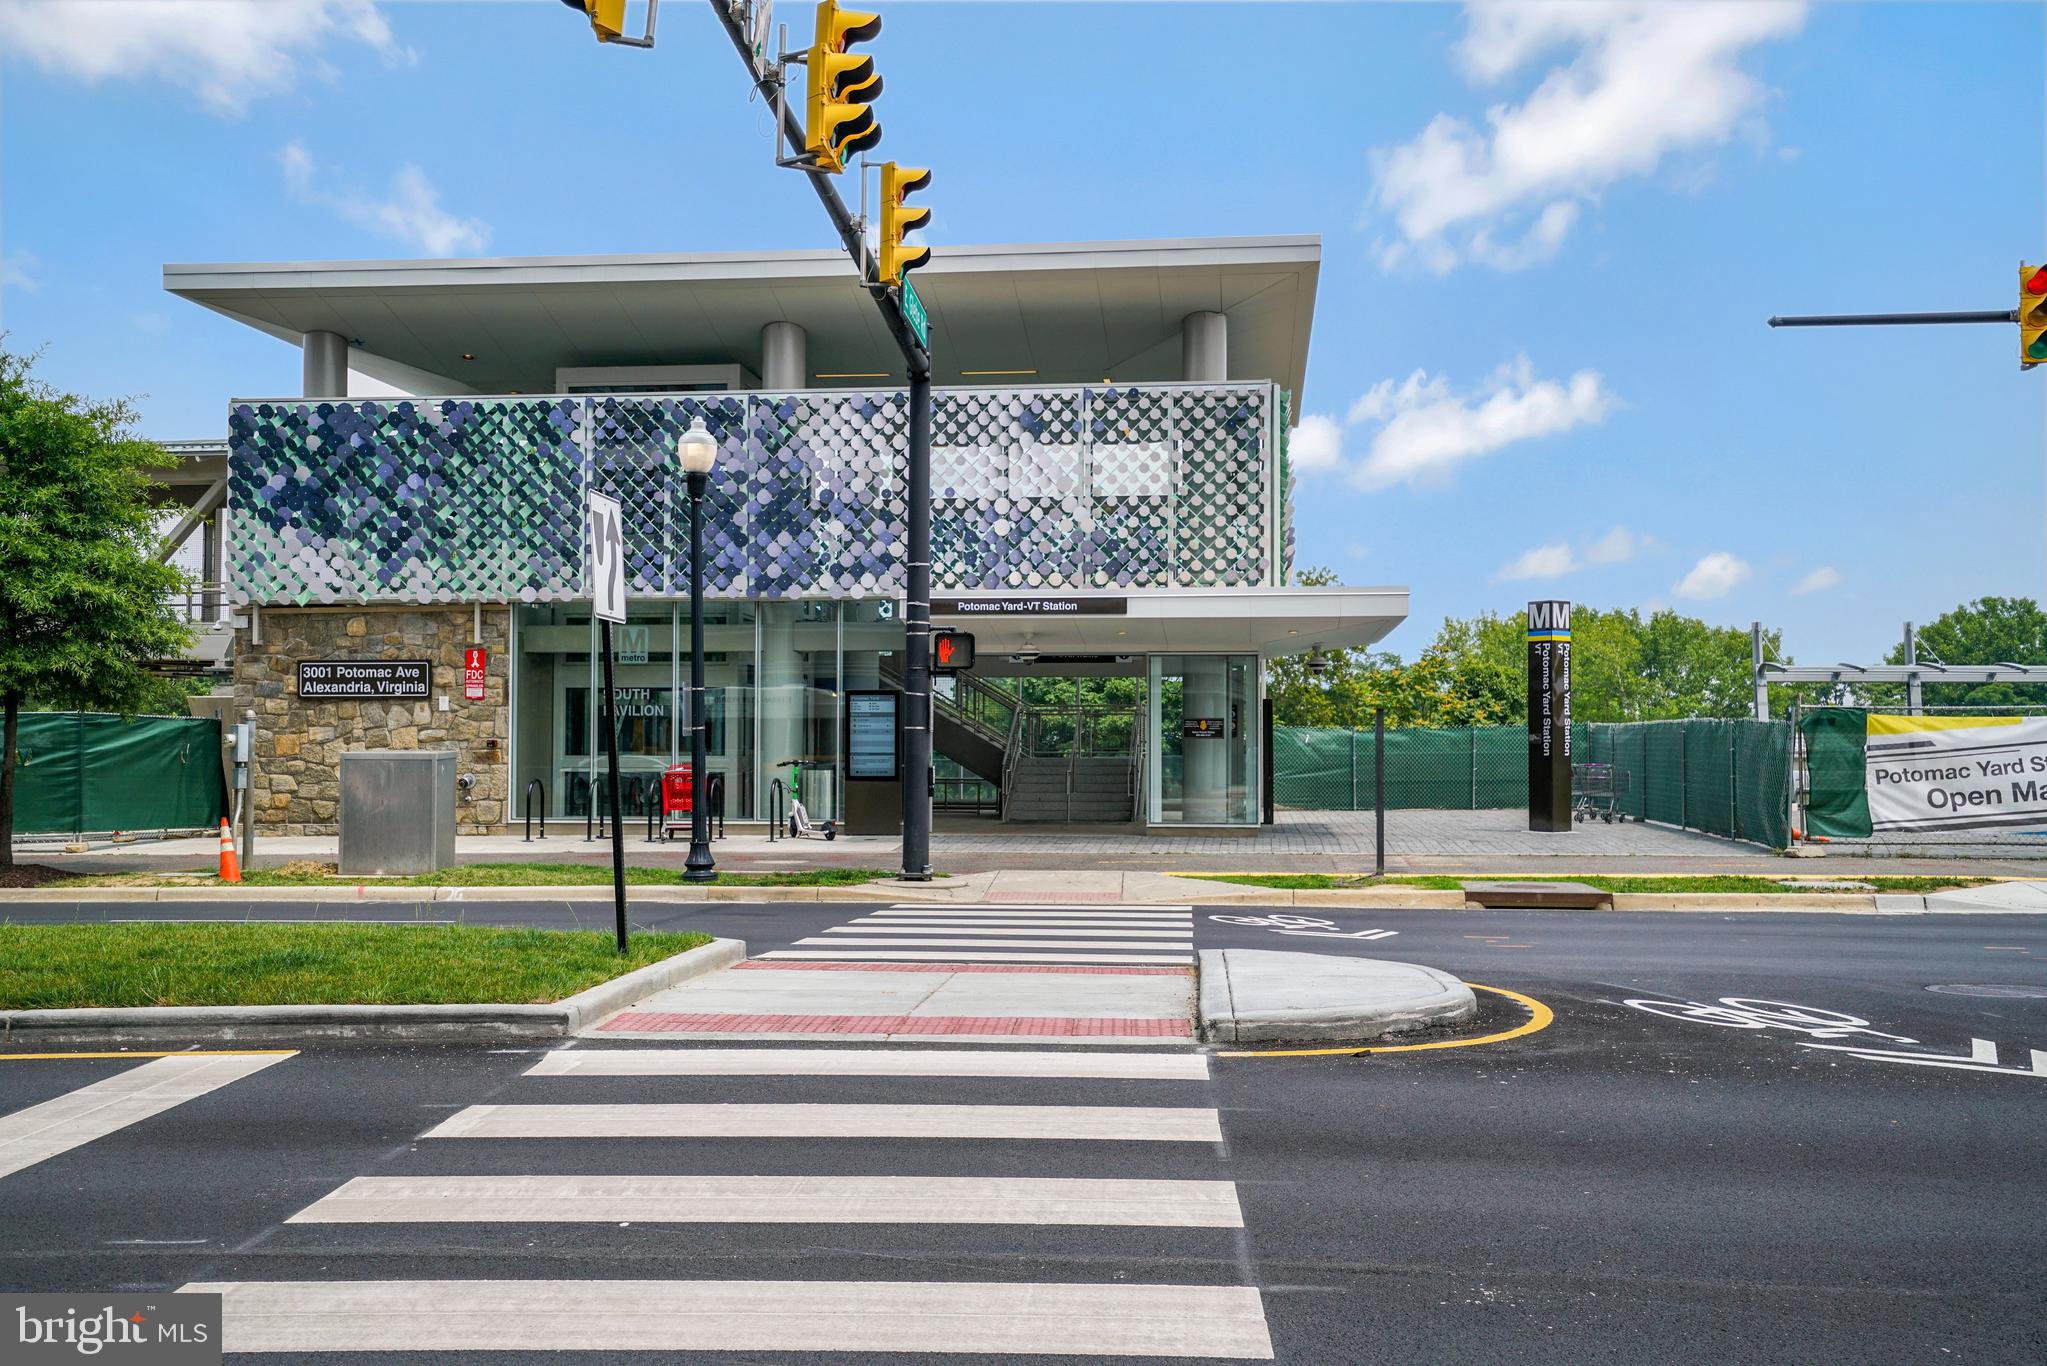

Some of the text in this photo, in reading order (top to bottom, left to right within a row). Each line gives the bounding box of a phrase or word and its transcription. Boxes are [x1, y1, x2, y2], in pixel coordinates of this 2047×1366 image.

[958, 601, 1078, 611] Potomac Yard-VT Station
[1529, 603, 1550, 629] M
[1552, 603, 1570, 629] M
[1535, 643, 1541, 655] VT
[1557, 643, 1563, 655] VT
[621, 654, 646, 662] metro
[303, 666, 420, 678] 3001 Potomac Ave
[466, 669, 484, 680] FDC
[303, 681, 426, 695] Alexandria, Virginia
[603, 688, 650, 700] OUTH
[1542, 643, 1551, 756] Potomac Yard Station
[1563, 690, 1571, 715] Yard
[1875, 766, 1971, 785] Potomac
[1976, 758, 2025, 777] Yard
[1926, 787, 2002, 813] Open
